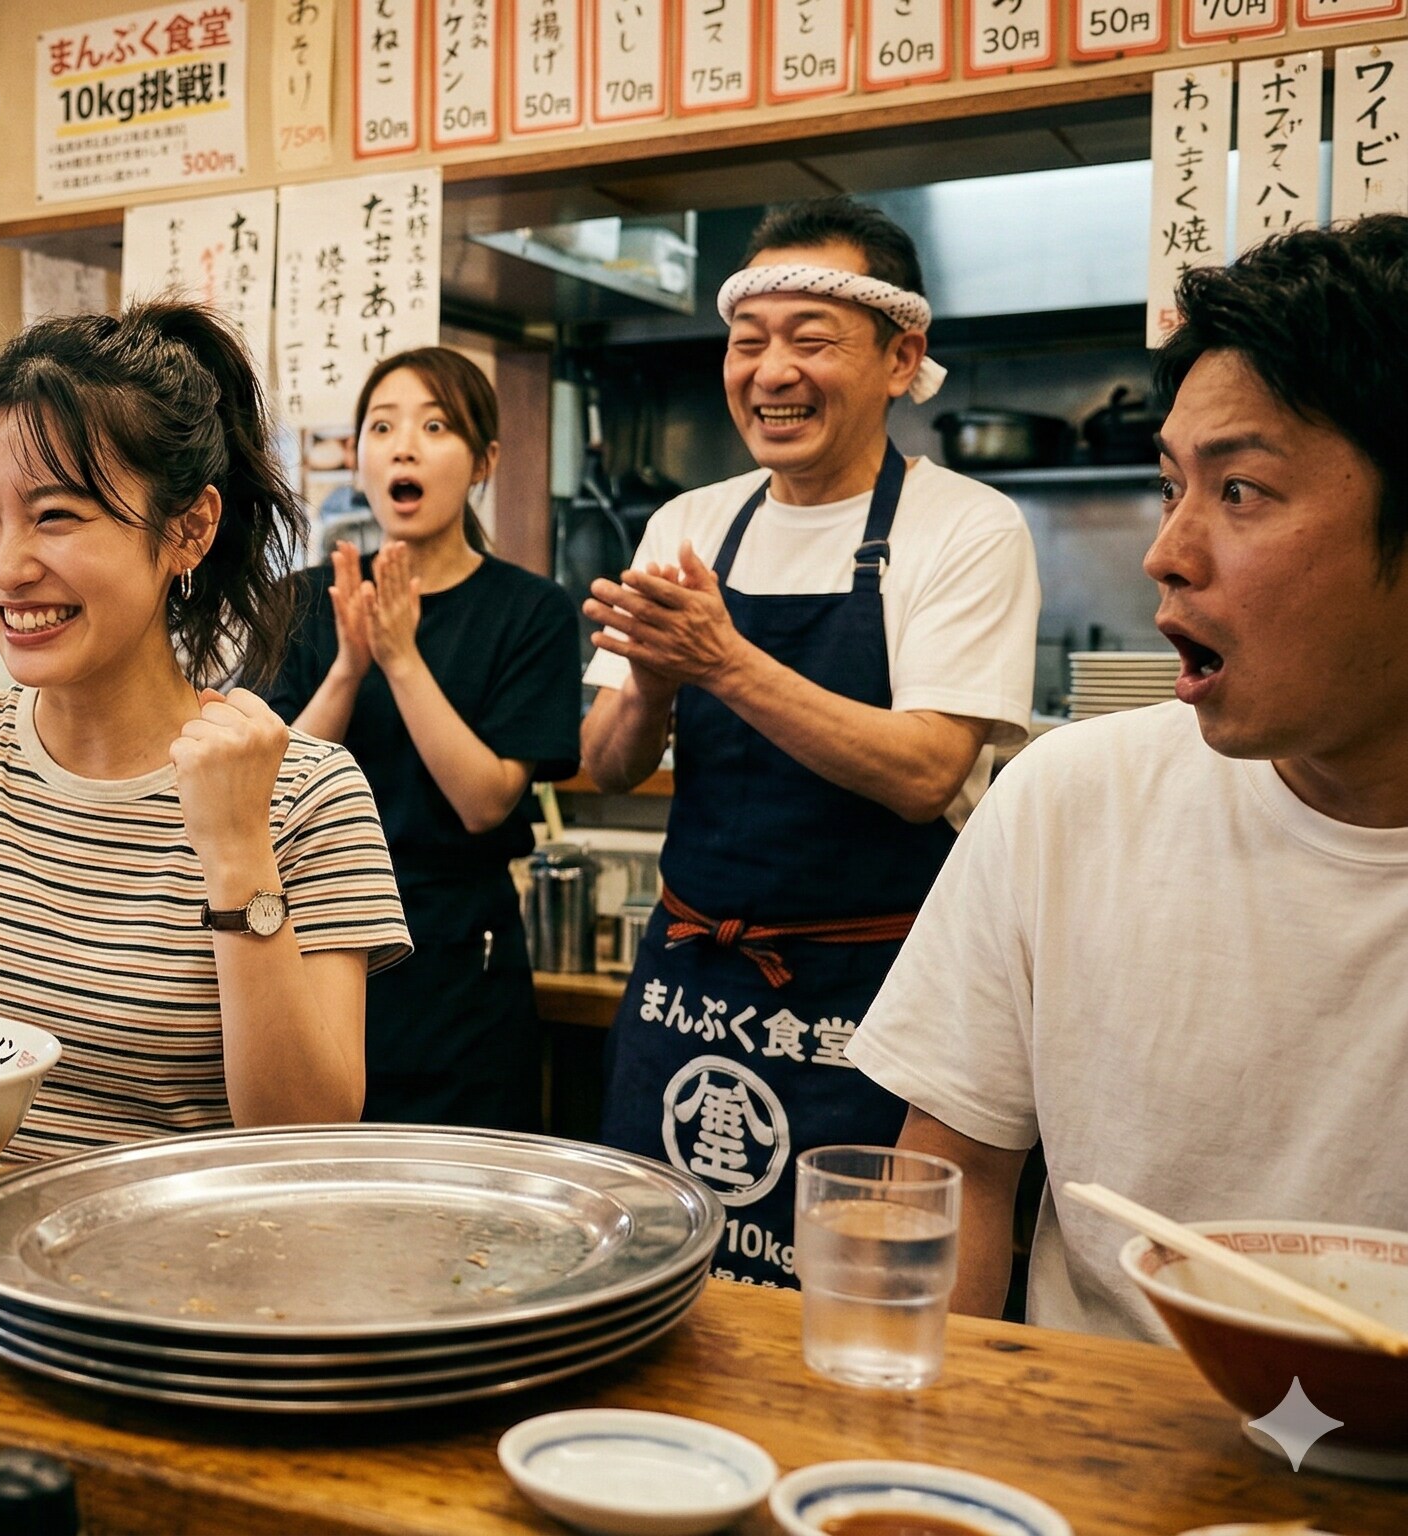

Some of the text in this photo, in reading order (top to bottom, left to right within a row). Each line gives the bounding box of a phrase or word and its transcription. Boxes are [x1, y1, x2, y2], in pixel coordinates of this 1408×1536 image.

[796, 0, 821, 34] と
[1088, 7, 1151, 37] 50円
[49, 6, 232, 75] まんぷく食堂
[443, 0, 463, 93] ケメン
[530, 0, 565, 76] 揚げ
[878, 38, 934, 67] 60円
[983, 25, 1040, 54] 30円
[691, 66, 743, 94] 75円
[782, 53, 836, 81] 50円
[59, 62, 227, 123] 10kg挑戦!
[524, 92, 572, 119] 50円
[605, 79, 654, 103] 70円
[365, 118, 409, 142] 30円
[442, 106, 488, 131] 50円
[1355, 60, 1400, 221] ワイビー
[640, 978, 857, 1069] まんぷく食堂
[725, 1218, 796, 1275] 10kg
